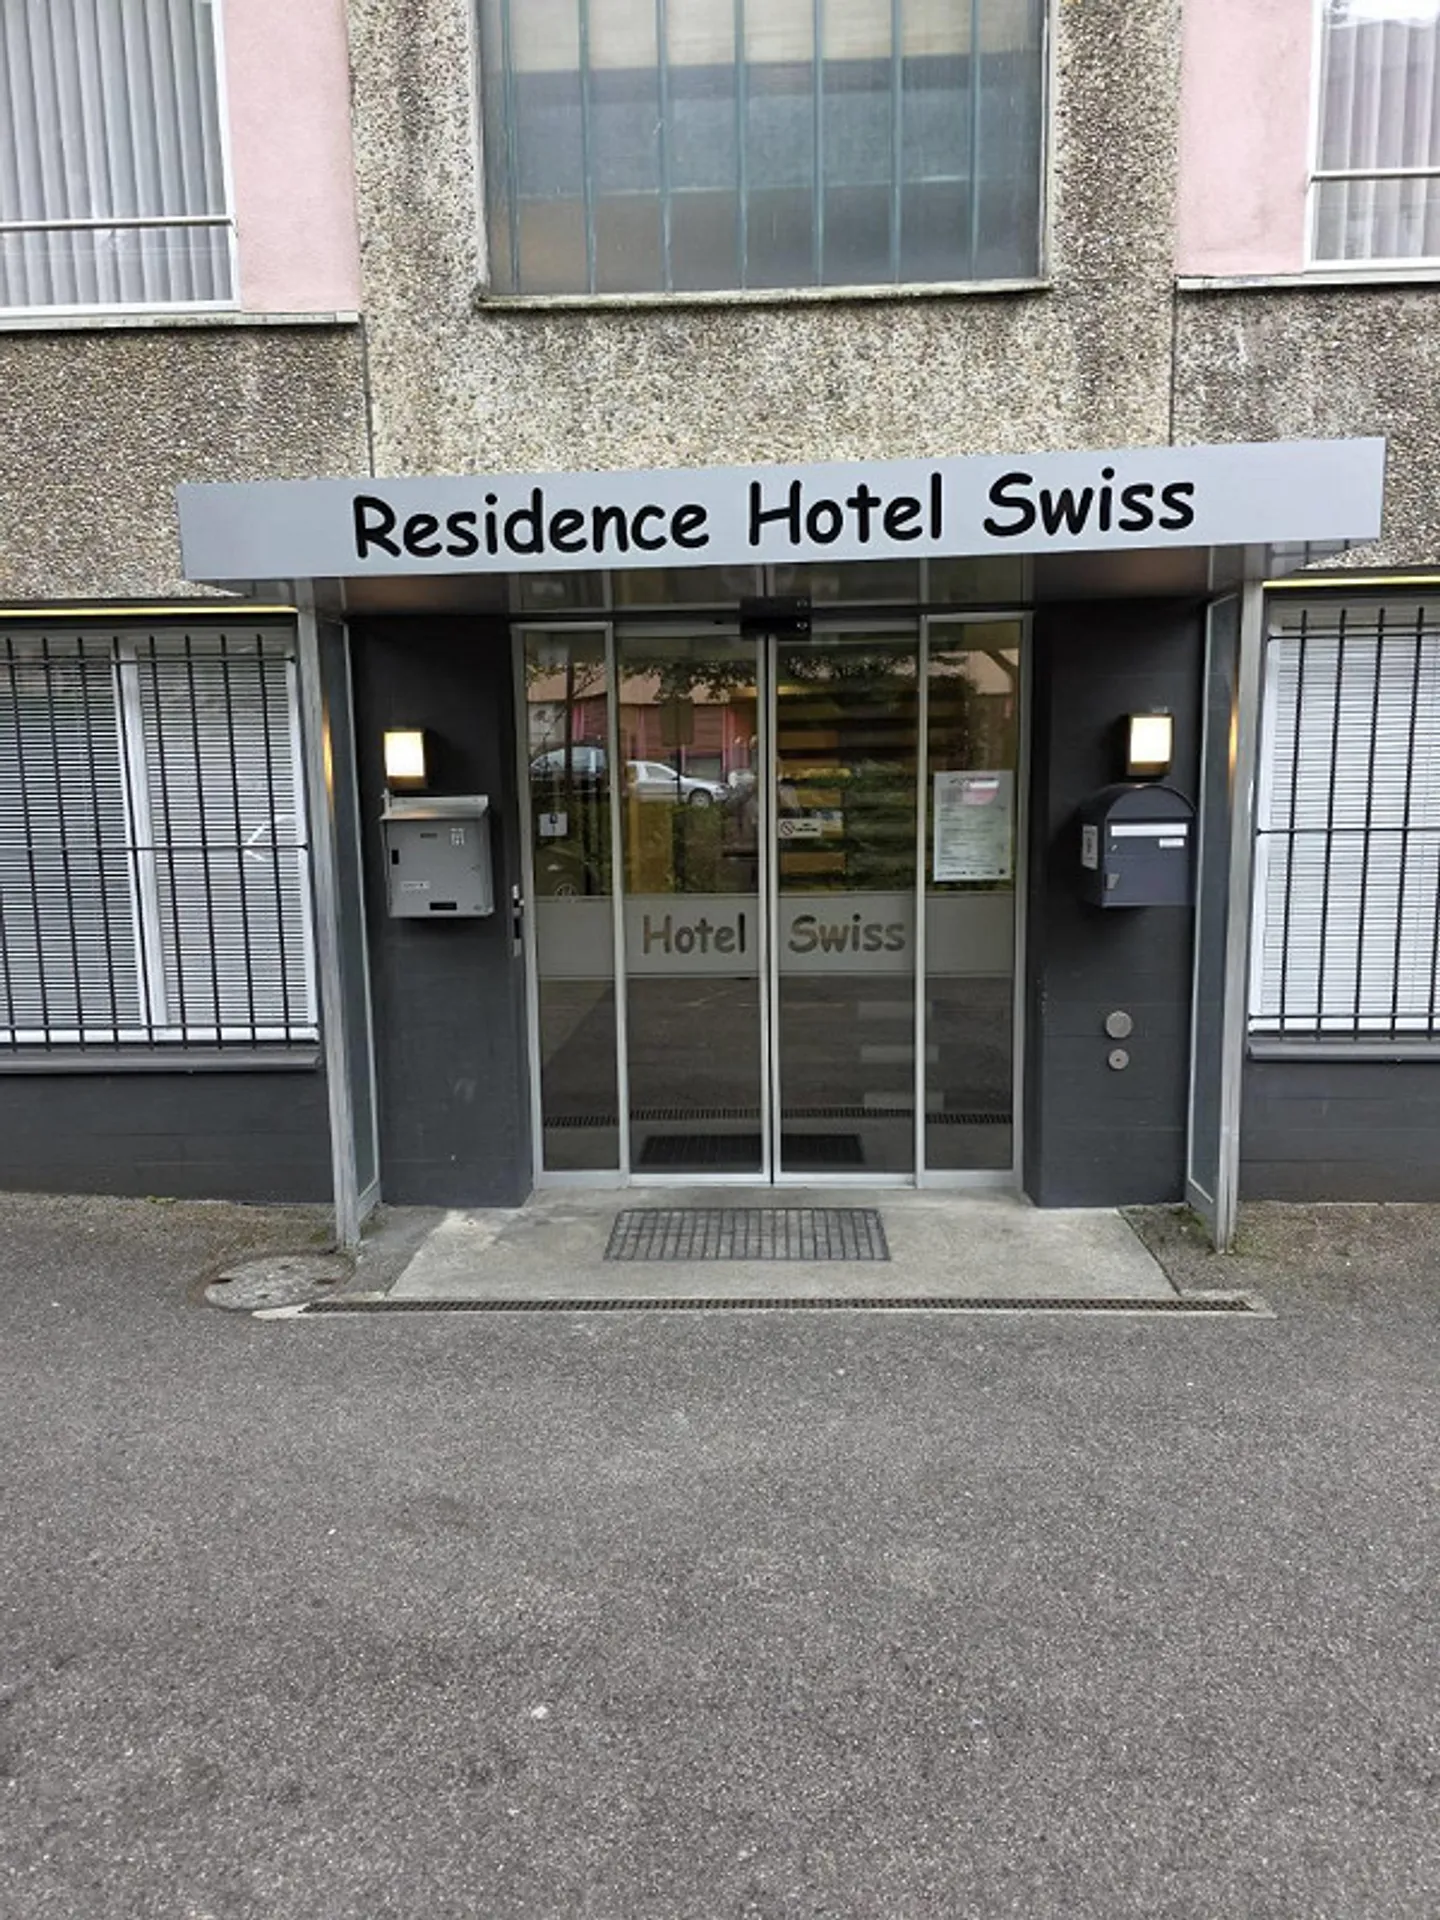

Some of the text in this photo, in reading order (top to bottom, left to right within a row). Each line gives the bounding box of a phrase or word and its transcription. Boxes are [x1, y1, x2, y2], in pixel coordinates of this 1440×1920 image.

[353, 467, 1194, 559] Residence Hotel Swiss
[643, 911, 907, 955] Hotel Swiss
